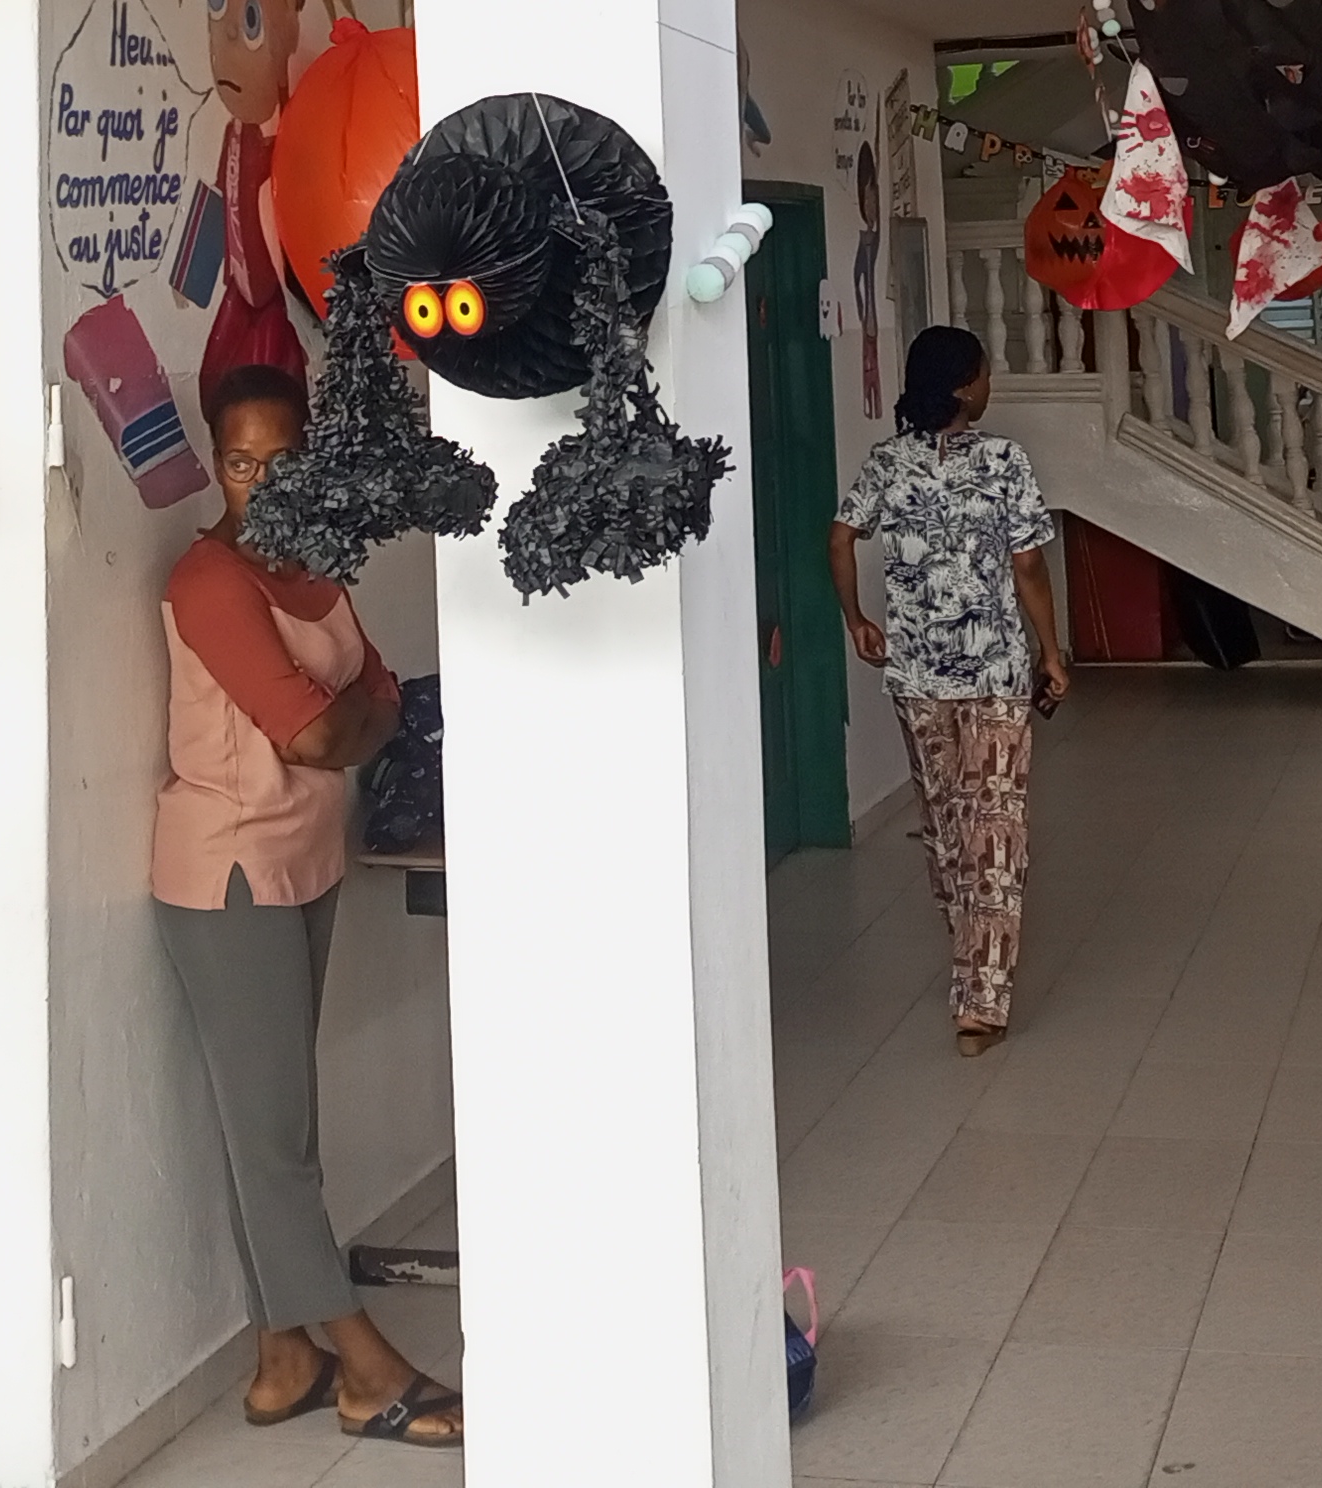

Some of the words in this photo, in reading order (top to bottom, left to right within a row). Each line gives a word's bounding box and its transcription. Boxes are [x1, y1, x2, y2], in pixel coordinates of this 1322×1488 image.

[58, 83, 91, 137] Par
[97, 85, 144, 162] quoi
[154, 89, 179, 173] je
[56, 173, 181, 208] commence
[69, 233, 100, 262] au
[103, 208, 162, 293] juste
